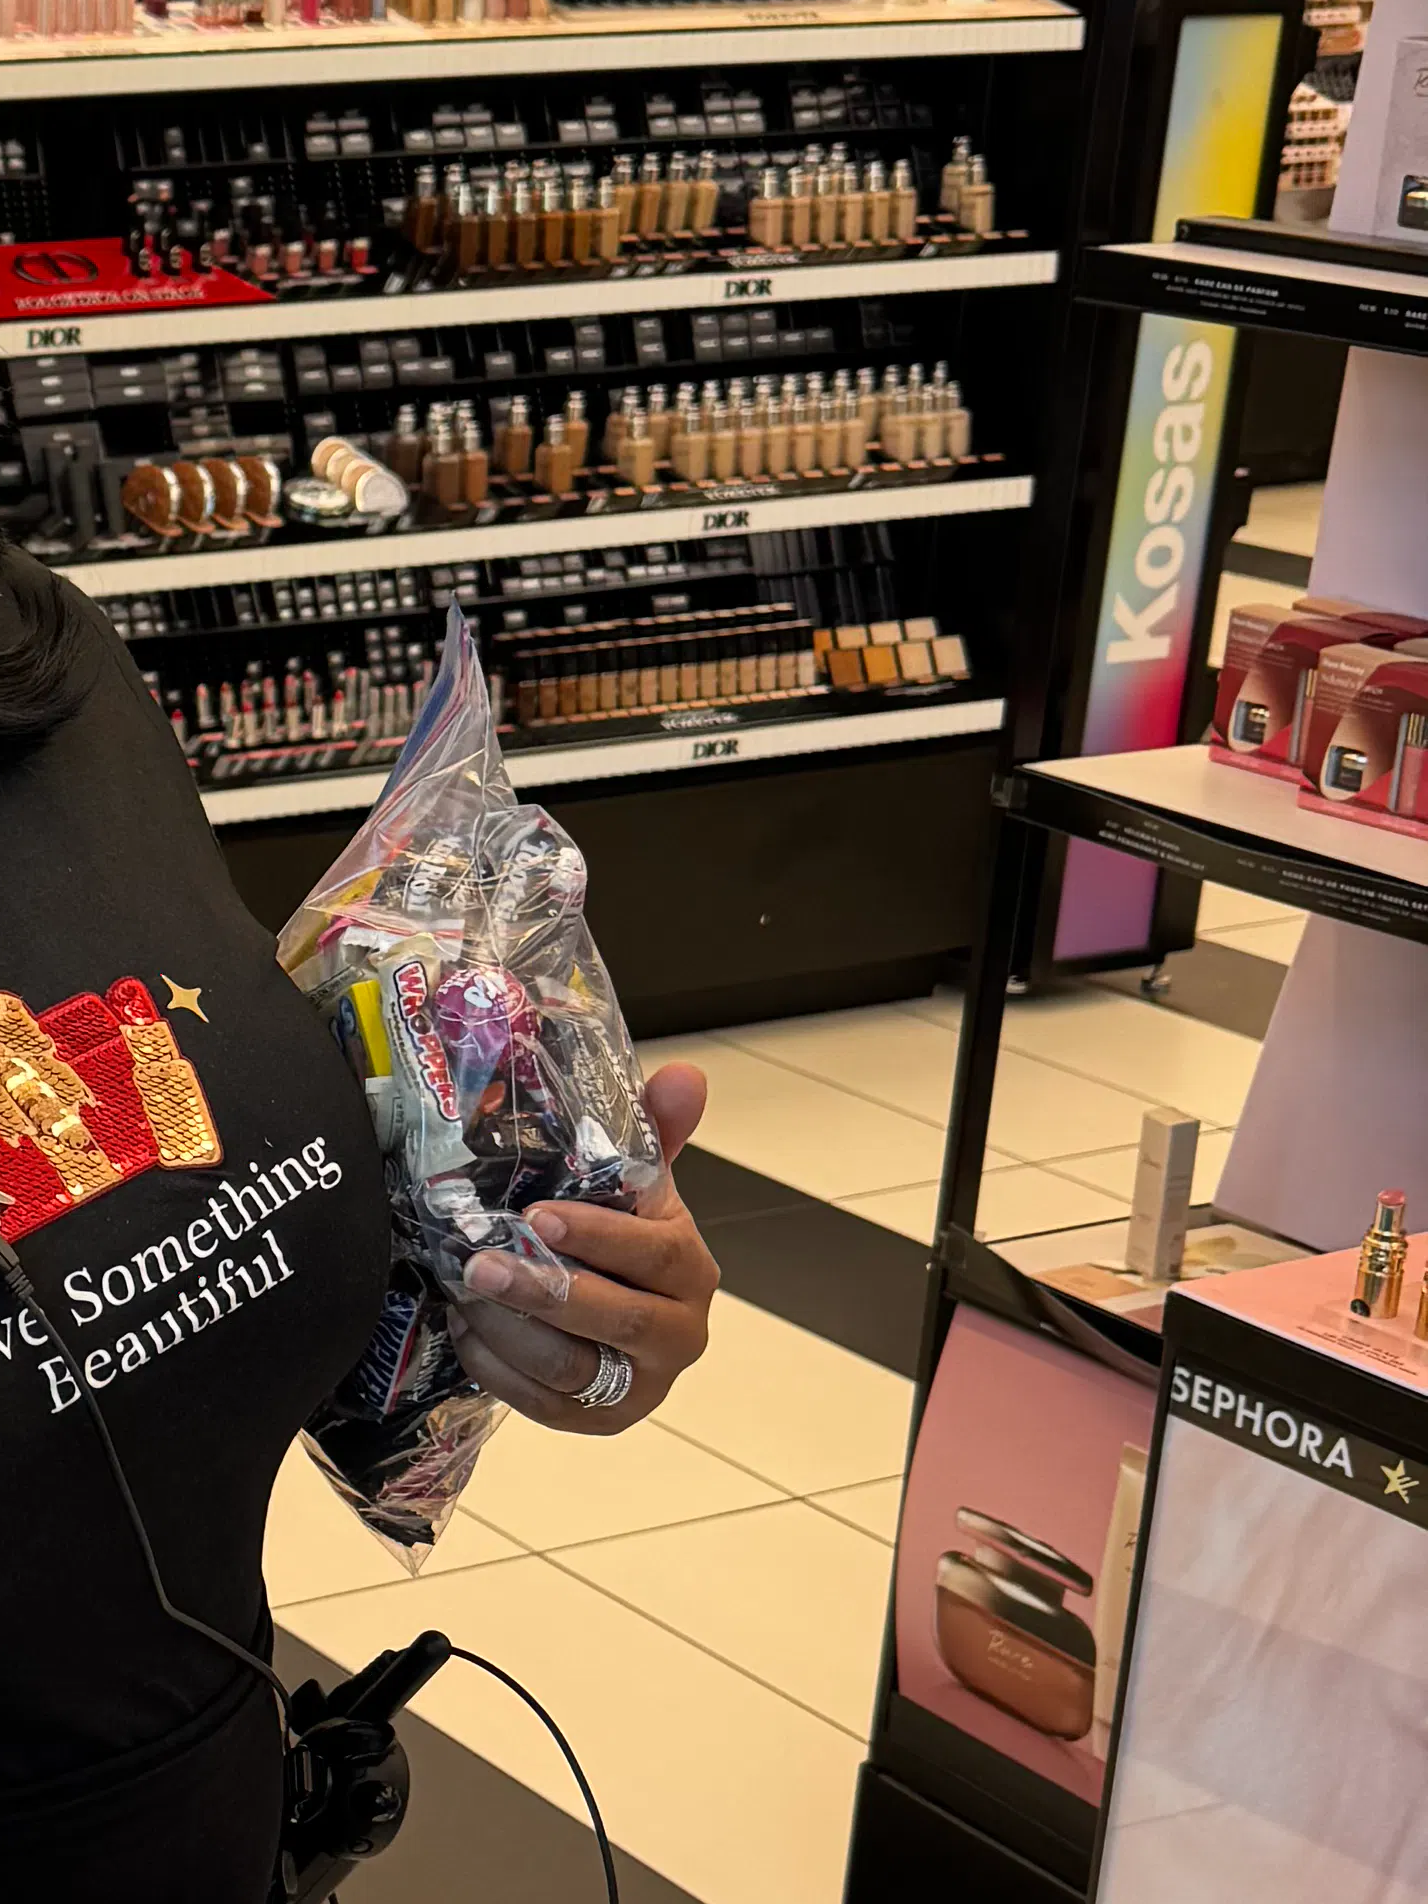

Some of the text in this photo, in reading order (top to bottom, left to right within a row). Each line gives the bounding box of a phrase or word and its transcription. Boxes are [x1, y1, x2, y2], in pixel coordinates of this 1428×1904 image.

[724, 278, 773, 299] DIOR
[27, 327, 82, 350] DIOR
[702, 510, 750, 531] DIOR
[1106, 336, 1213, 668] Kosas
[691, 738, 740, 760] DIOR
[62, 1135, 343, 1327] Something
[36, 1231, 295, 1415] Beautiful
[1170, 1365, 1355, 1478] SEPHORA
